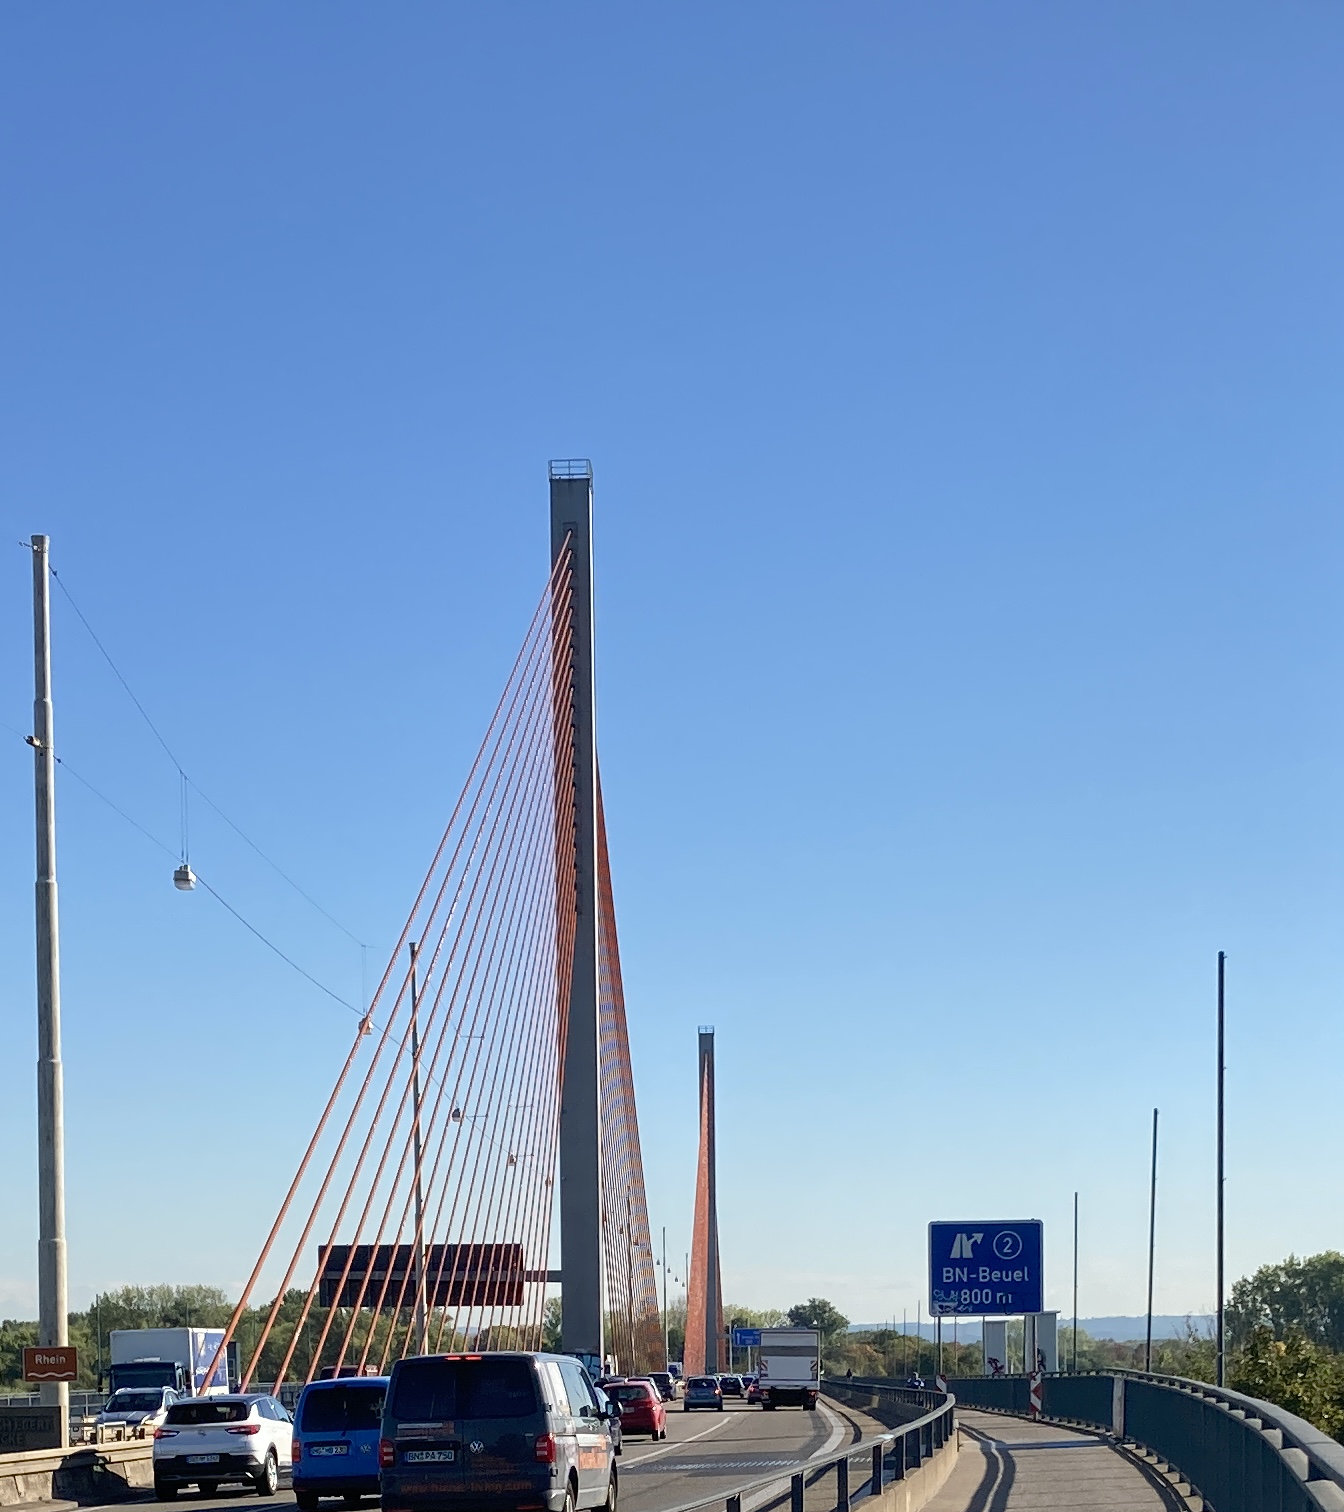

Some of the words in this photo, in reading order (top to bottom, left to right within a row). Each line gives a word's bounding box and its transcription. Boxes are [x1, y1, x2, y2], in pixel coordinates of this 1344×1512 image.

[1002, 1237, 1013, 1253] 2
[942, 1266, 1029, 1283] BN-Beuel
[960, 1288, 992, 1305] 800
[996, 1292, 1013, 1304] m
[34, 1354, 66, 1365] Rhein
[408, 1451, 420, 1461] BN
